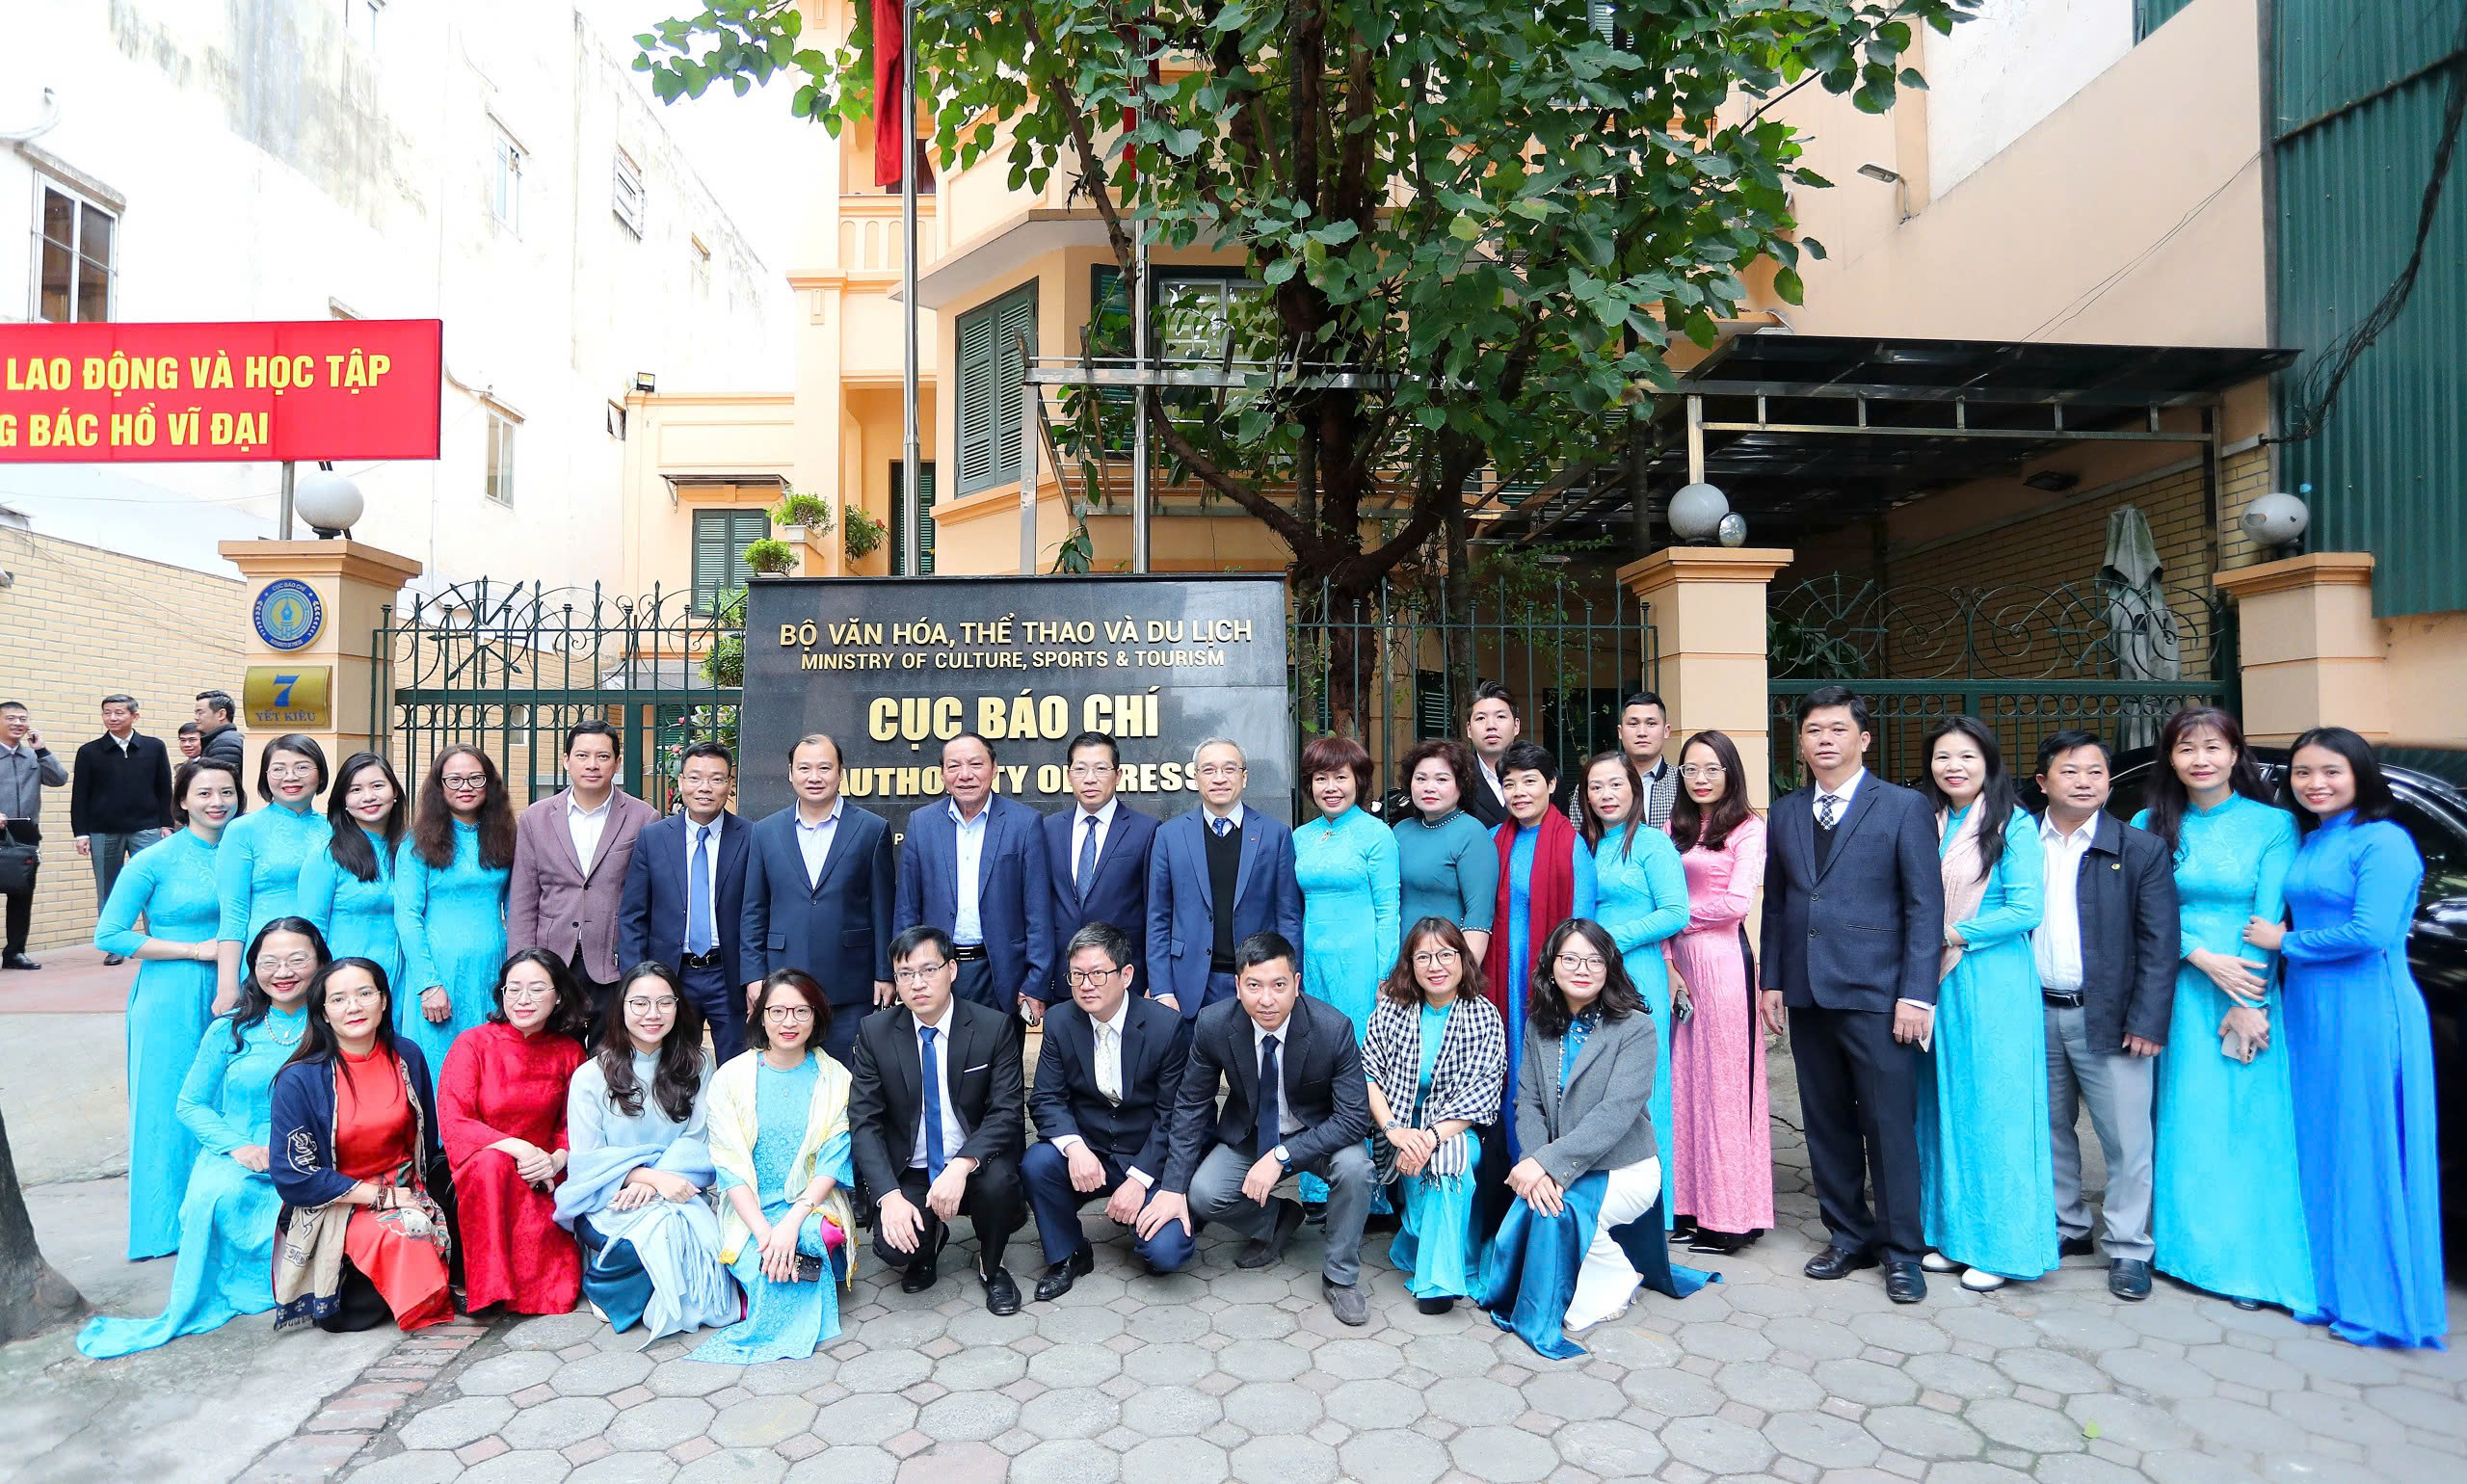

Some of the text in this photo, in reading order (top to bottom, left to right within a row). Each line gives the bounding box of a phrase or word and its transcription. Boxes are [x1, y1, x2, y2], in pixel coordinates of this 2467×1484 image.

[7, 348, 391, 397] LAO ĐỘNG VÀ HỌC TẬP
[29, 407, 99, 447] BÁC
[111, 403, 156, 446] HỒ
[168, 407, 202, 446] VĨ
[210, 412, 269, 452] ĐẠI
[780, 613, 1252, 651] BỘ VĂN HÓA, THỂ THAO VÀ DU LỊCH
[801, 649, 1225, 671] MINISTRY OF CULTURE, SPORTS & TOURISM
[272, 674, 301, 707] 7
[868, 685, 1161, 751] CỤC BÁO CHÍ
